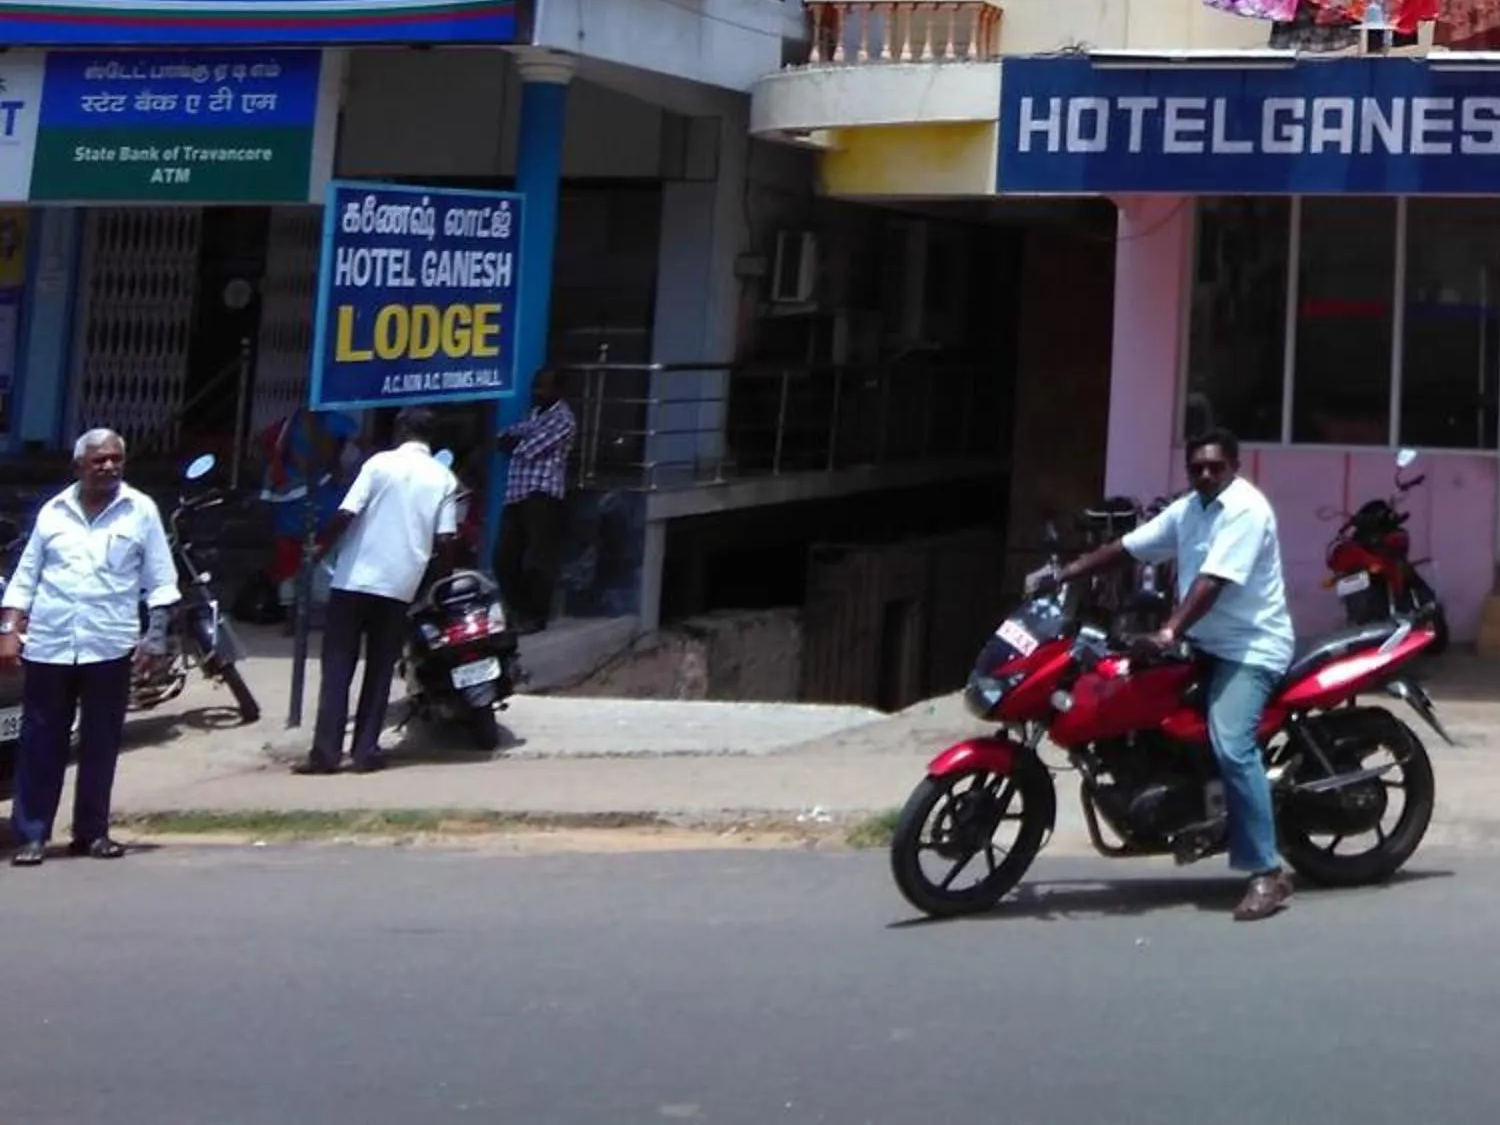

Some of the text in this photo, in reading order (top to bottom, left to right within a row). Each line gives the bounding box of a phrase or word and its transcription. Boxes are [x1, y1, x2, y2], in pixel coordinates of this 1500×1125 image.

[73, 145, 273, 162] State Bank of Travancore
[150, 168, 191, 184] ATM
[342, 194, 437, 241] கணேஷ்
[335, 247, 513, 288] HOTEL GANESH
[336, 303, 504, 363] LODGE
